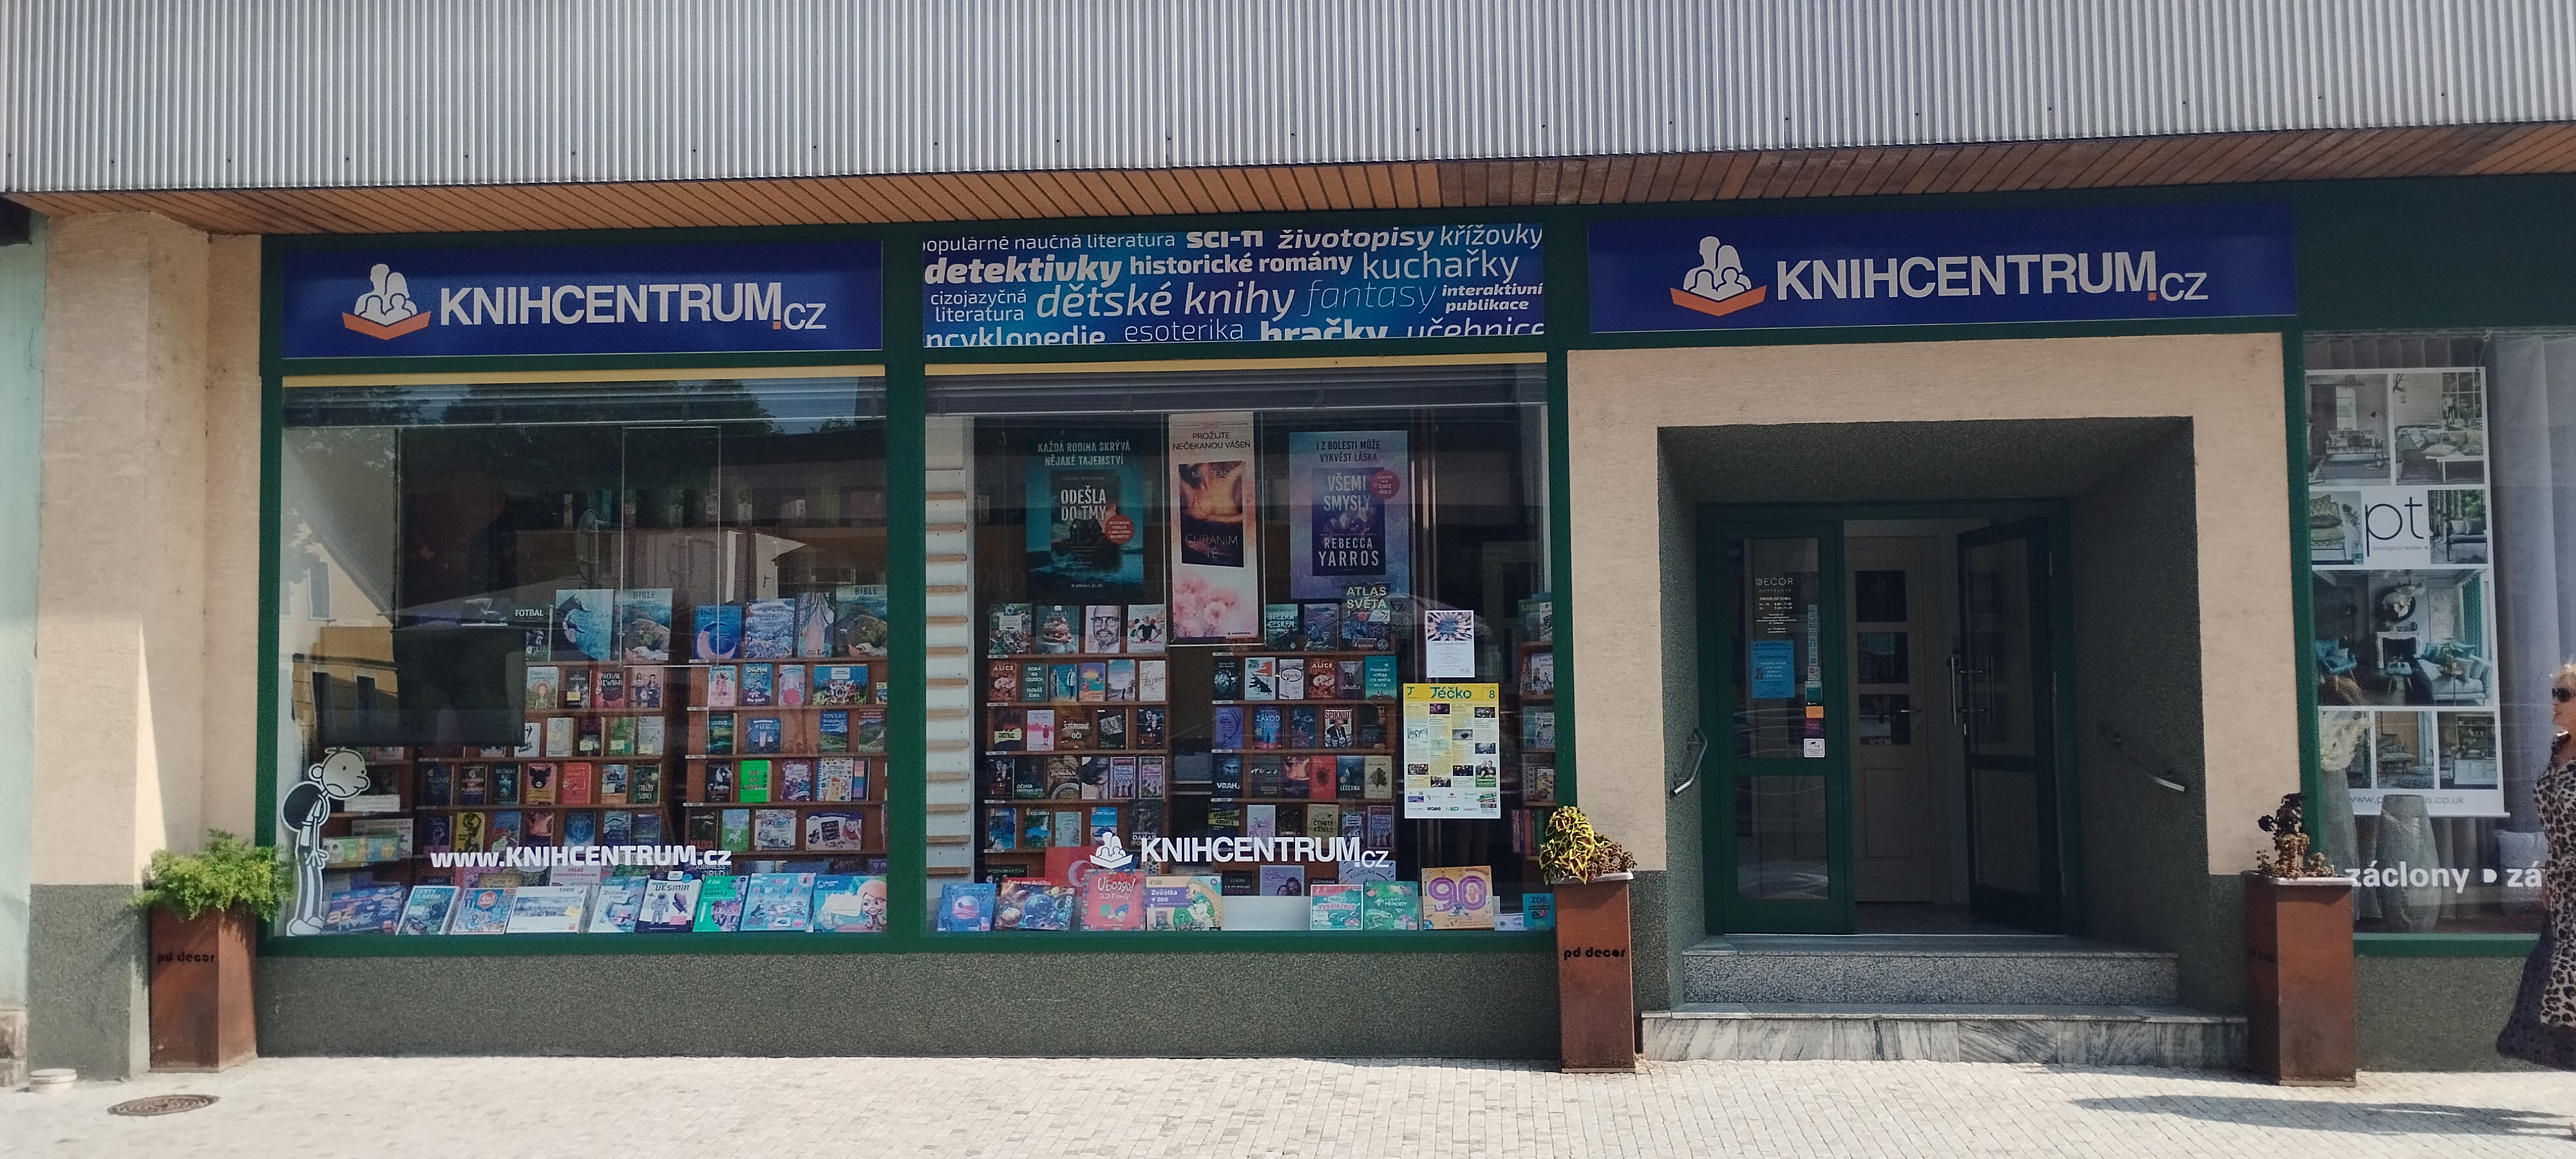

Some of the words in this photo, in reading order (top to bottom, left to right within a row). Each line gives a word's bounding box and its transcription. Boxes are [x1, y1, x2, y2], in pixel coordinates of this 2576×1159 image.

[923, 236, 1009, 254] opulárně
[1015, 234, 1081, 250] naučná
[1087, 233, 1175, 248] literatura
[1278, 227, 1435, 251] životopisy
[1441, 223, 1542, 249] křížovky
[924, 254, 1122, 288] detektivky
[1131, 252, 1253, 276] historické
[1259, 250, 1353, 275] romány
[1363, 249, 1519, 284] kuchařky
[931, 289, 1027, 307] cizojazyčná
[1301, 279, 1437, 317] fantasy
[1442, 283, 1543, 296] interaktivní
[1036, 281, 1173, 317] dětské
[1183, 281, 1295, 321] knihy
[1445, 298, 1530, 314] publikace
[935, 306, 1025, 323] literatura
[926, 324, 1106, 346] ncyklopedie
[1125, 319, 1242, 343] esoterika
[1260, 317, 1388, 341] hračky
[1192, 431, 1231, 440] PROŽIJTE
[1038, 440, 1064, 452] KAŽDÁ
[1066, 442, 1097, 451] RODINA
[1099, 439, 1130, 451] SKRÝVÁ
[1172, 442, 1224, 451] NEČEKANOU
[1225, 439, 1251, 449] VÁŠEŇ
[1316, 442, 1319, 451] I
[1328, 440, 1358, 449] BOLESTI
[1360, 439, 1381, 449] MŮŽE
[1045, 454, 1075, 466] NĚJAKÉ
[1078, 453, 1124, 466] TAJEMSTVÍ
[1320, 452, 1352, 462] VYKVÉST
[1354, 451, 1378, 462] LÁSKA
[1327, 472, 1367, 492] VŠEMI
[1061, 484, 1106, 504] ODEŠLA
[1323, 495, 1371, 511] SMYSLY
[1061, 505, 1077, 521] DO
[1081, 505, 1106, 521] TMY
[2365, 496, 2424, 557] pt
[1185, 533, 1238, 546] CHRÁNÍM
[1324, 537, 1373, 549] REBECCA
[1318, 550, 1379, 567] YARROS
[855, 587, 877, 595] BIBLE
[1346, 587, 1387, 596] ATLAS
[1347, 598, 1387, 609] SVĚTA
[1430, 686, 1472, 699] Téčko
[1489, 690, 1495, 699] 8
[431, 845, 732, 868] www.KNIHCENTRUM.cz
[1097, 877, 1136, 894] Ubongo!
[2345, 860, 2470, 894] záclony
[1111, 892, 1131, 901] Family
[1428, 875, 1488, 912] 90
[156, 952, 173, 964] pd
[178, 952, 215, 963] decor
[1564, 947, 1581, 961] pd
[1585, 947, 1625, 957] decor
